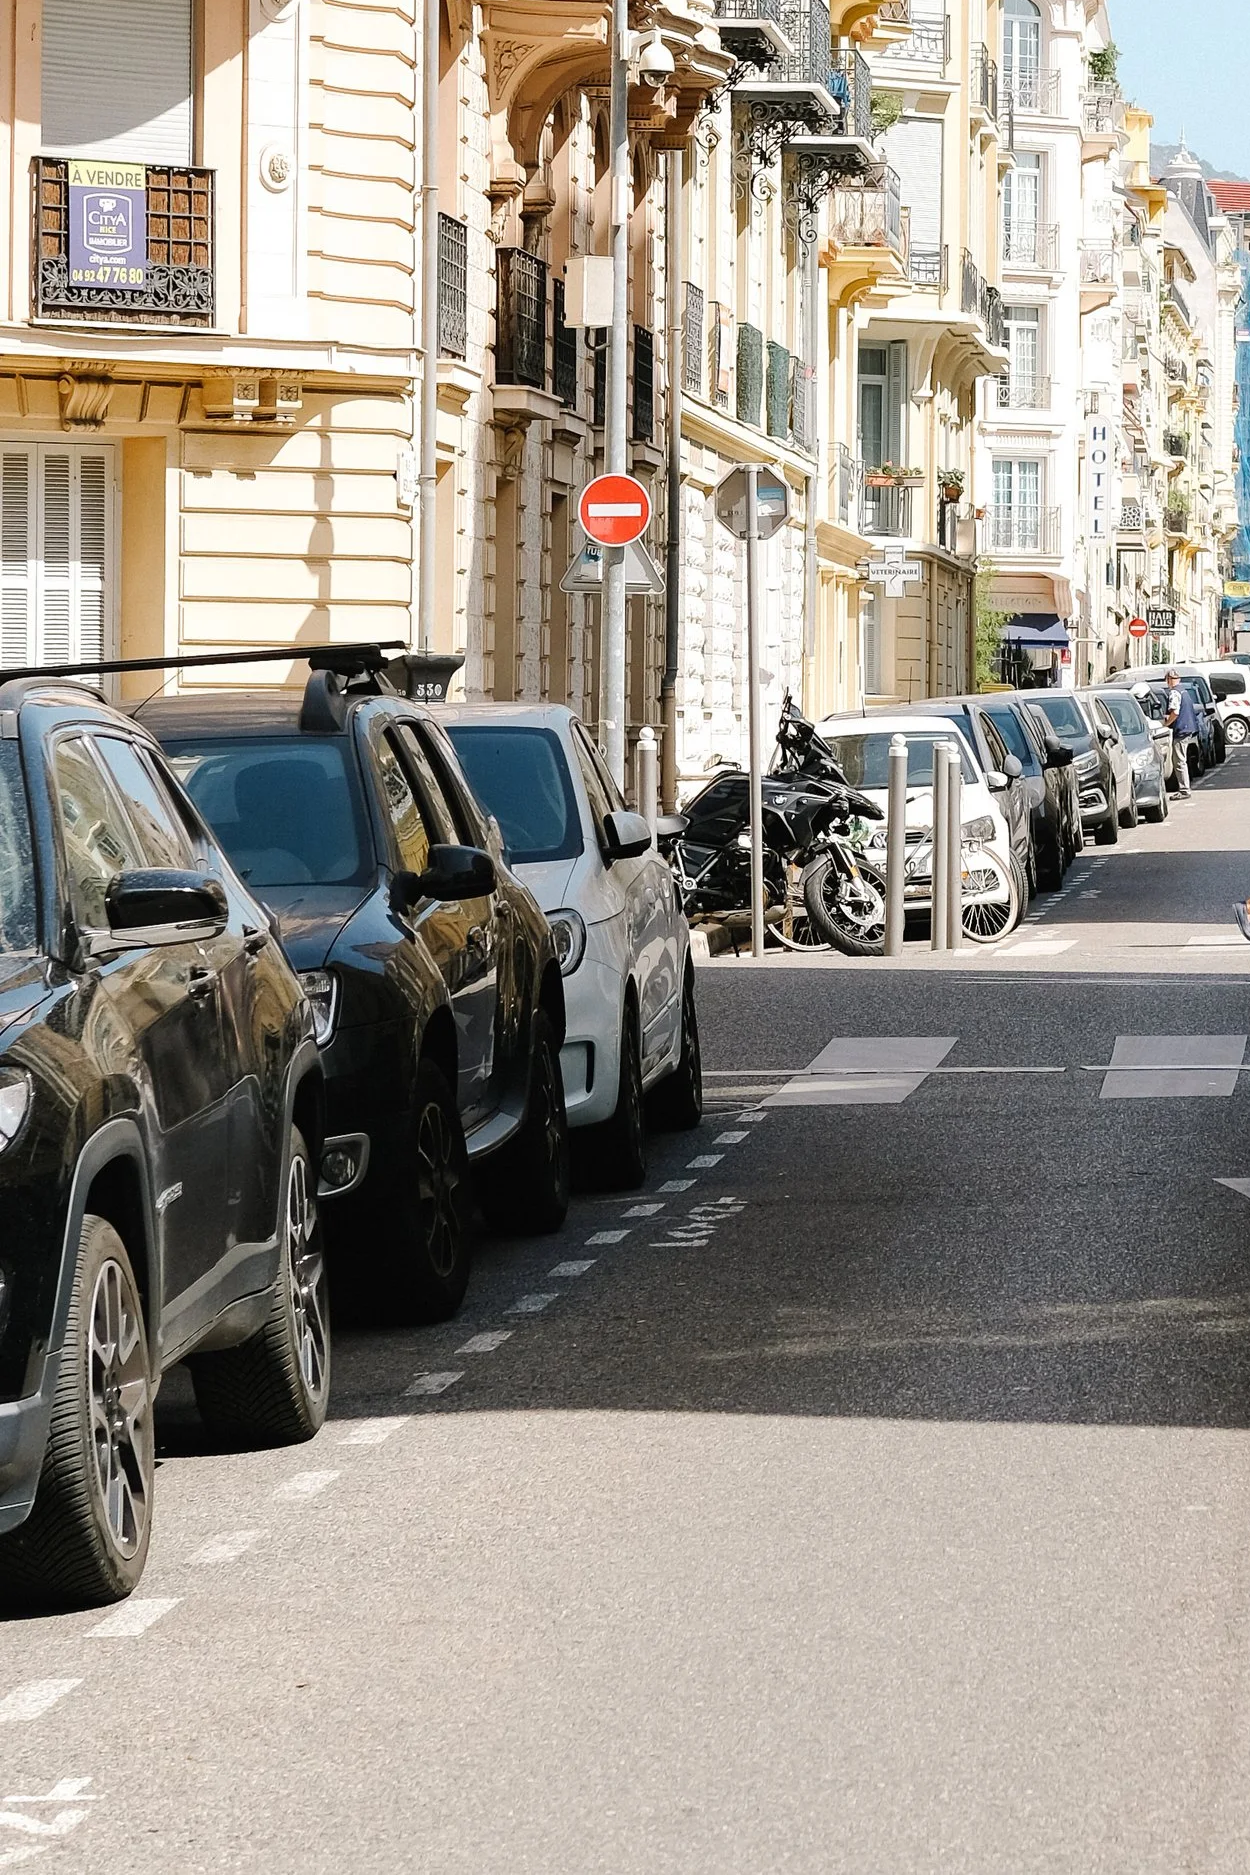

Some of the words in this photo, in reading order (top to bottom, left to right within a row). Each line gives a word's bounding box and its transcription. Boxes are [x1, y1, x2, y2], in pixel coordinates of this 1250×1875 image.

[86, 169, 142, 187] VENDRE
[88, 237, 128, 246] IMMOBILIER
[89, 254, 126, 265] citya.com
[96, 266, 111, 283] 47
[112, 267, 128, 284] 76
[128, 267, 144, 285] 80
[1091, 426, 1107, 534] HOTEL
